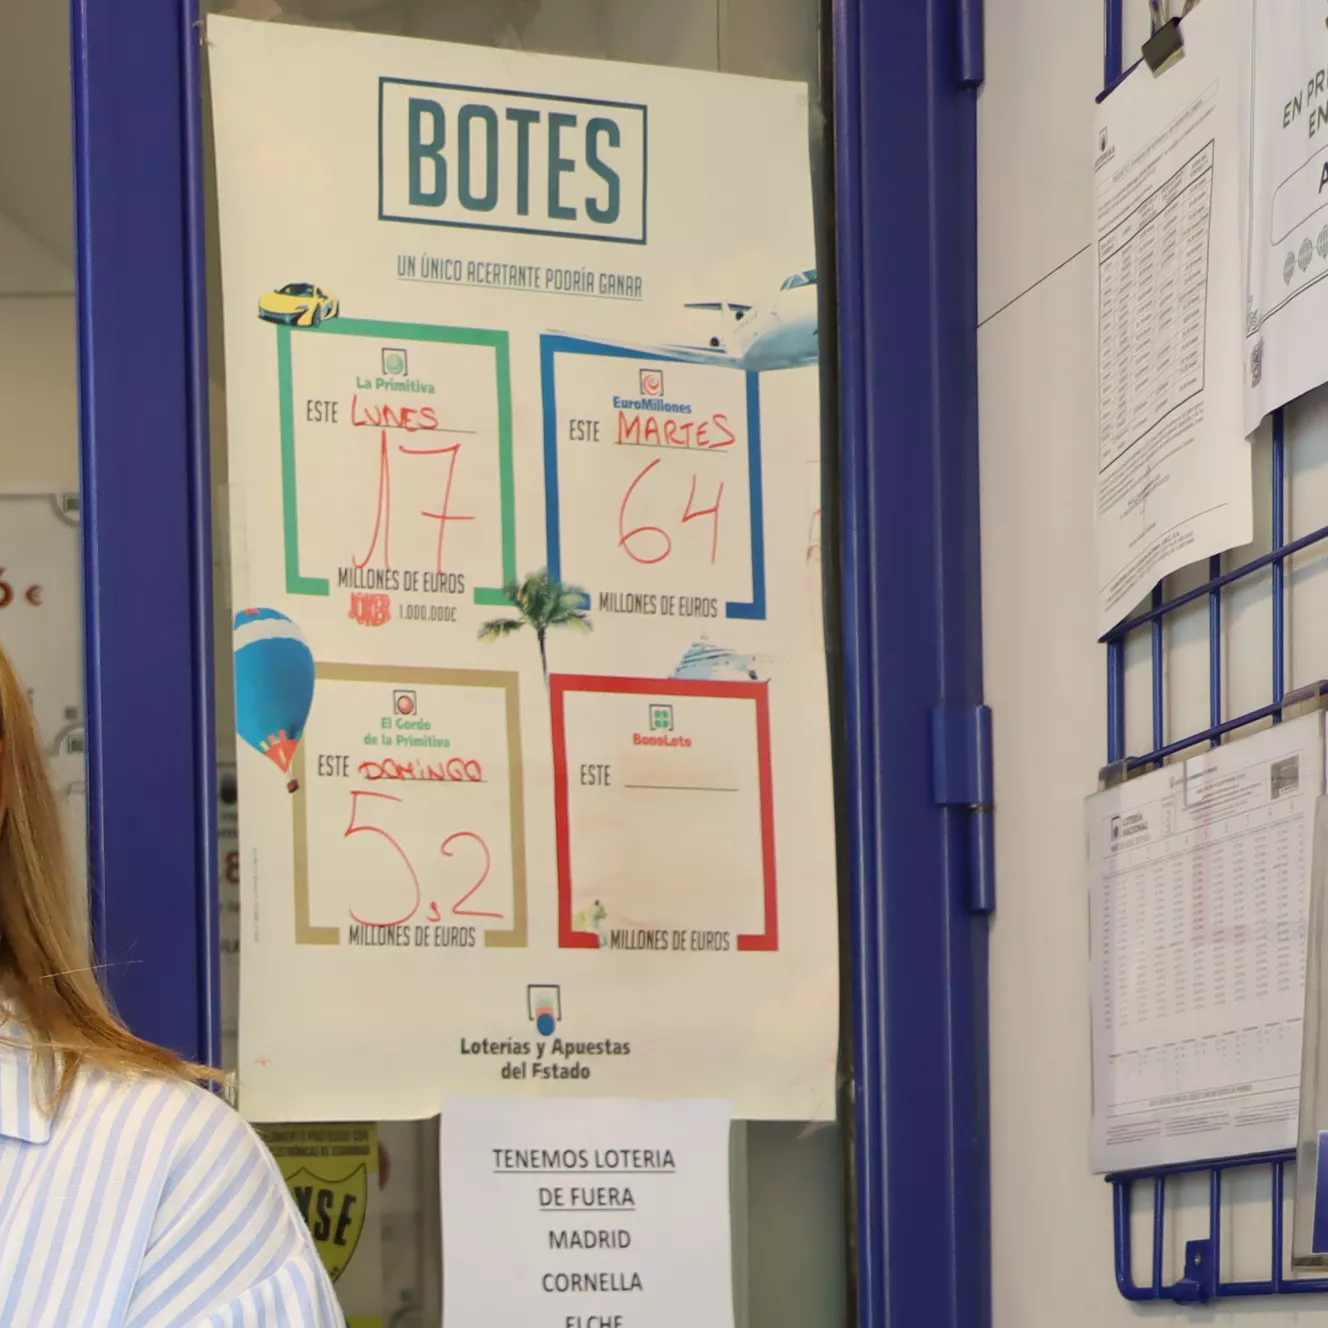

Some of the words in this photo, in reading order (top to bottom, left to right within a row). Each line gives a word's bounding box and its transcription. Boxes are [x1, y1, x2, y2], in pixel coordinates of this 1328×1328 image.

[407, 97, 621, 224] BOTES
[397, 254, 415, 277] UN
[421, 252, 462, 281] ÚNICO
[467, 261, 541, 288] ACERTANTE
[546, 266, 594, 293] PODRÍA
[599, 273, 643, 298] GANAR
[356, 376, 372, 389] La
[376, 378, 435, 394] Primitiva
[306, 400, 338, 423] ESTE
[351, 394, 438, 432] LUNES
[613, 396, 692, 414] EuroMillones
[569, 419, 600, 442] ESTE
[617, 411, 736, 448] MARTES
[352, 429, 476, 574] 17
[618, 459, 724, 564] 64
[338, 567, 399, 590] MILLONES
[404, 570, 420, 591] DE
[424, 572, 465, 593] EUROS
[599, 592, 657, 615] MILLONES
[661, 595, 675, 616] DE
[679, 597, 718, 618] EUROS
[381, 717, 392, 729] El
[396, 718, 431, 730] Gordo
[364, 734, 378, 746] de
[382, 734, 392, 746] la
[396, 735, 451, 748] Primitiva
[633, 733, 692, 748] BonoLoto
[318, 755, 350, 777] ESTE
[580, 764, 611, 786] ESTE
[349, 925, 411, 946] MILLONES
[415, 926, 429, 946] DE
[435, 927, 476, 947] EUROS
[610, 930, 668, 950] MILLONES
[672, 931, 687, 950] DE
[691, 931, 730, 951] EUROS
[460, 1037, 531, 1055] Loterías
[536, 1041, 545, 1059] y
[551, 1038, 631, 1059] Apuestas
[501, 1061, 526, 1079] del
[532, 1061, 591, 1079] Estado
[493, 1149, 589, 1169] TENEMOS
[595, 1148, 676, 1169] LOTERIA
[538, 1188, 565, 1207] DE
[571, 1187, 635, 1207] FUERA
[548, 1230, 631, 1249] MADRID
[542, 1272, 643, 1292] CORNELLA
